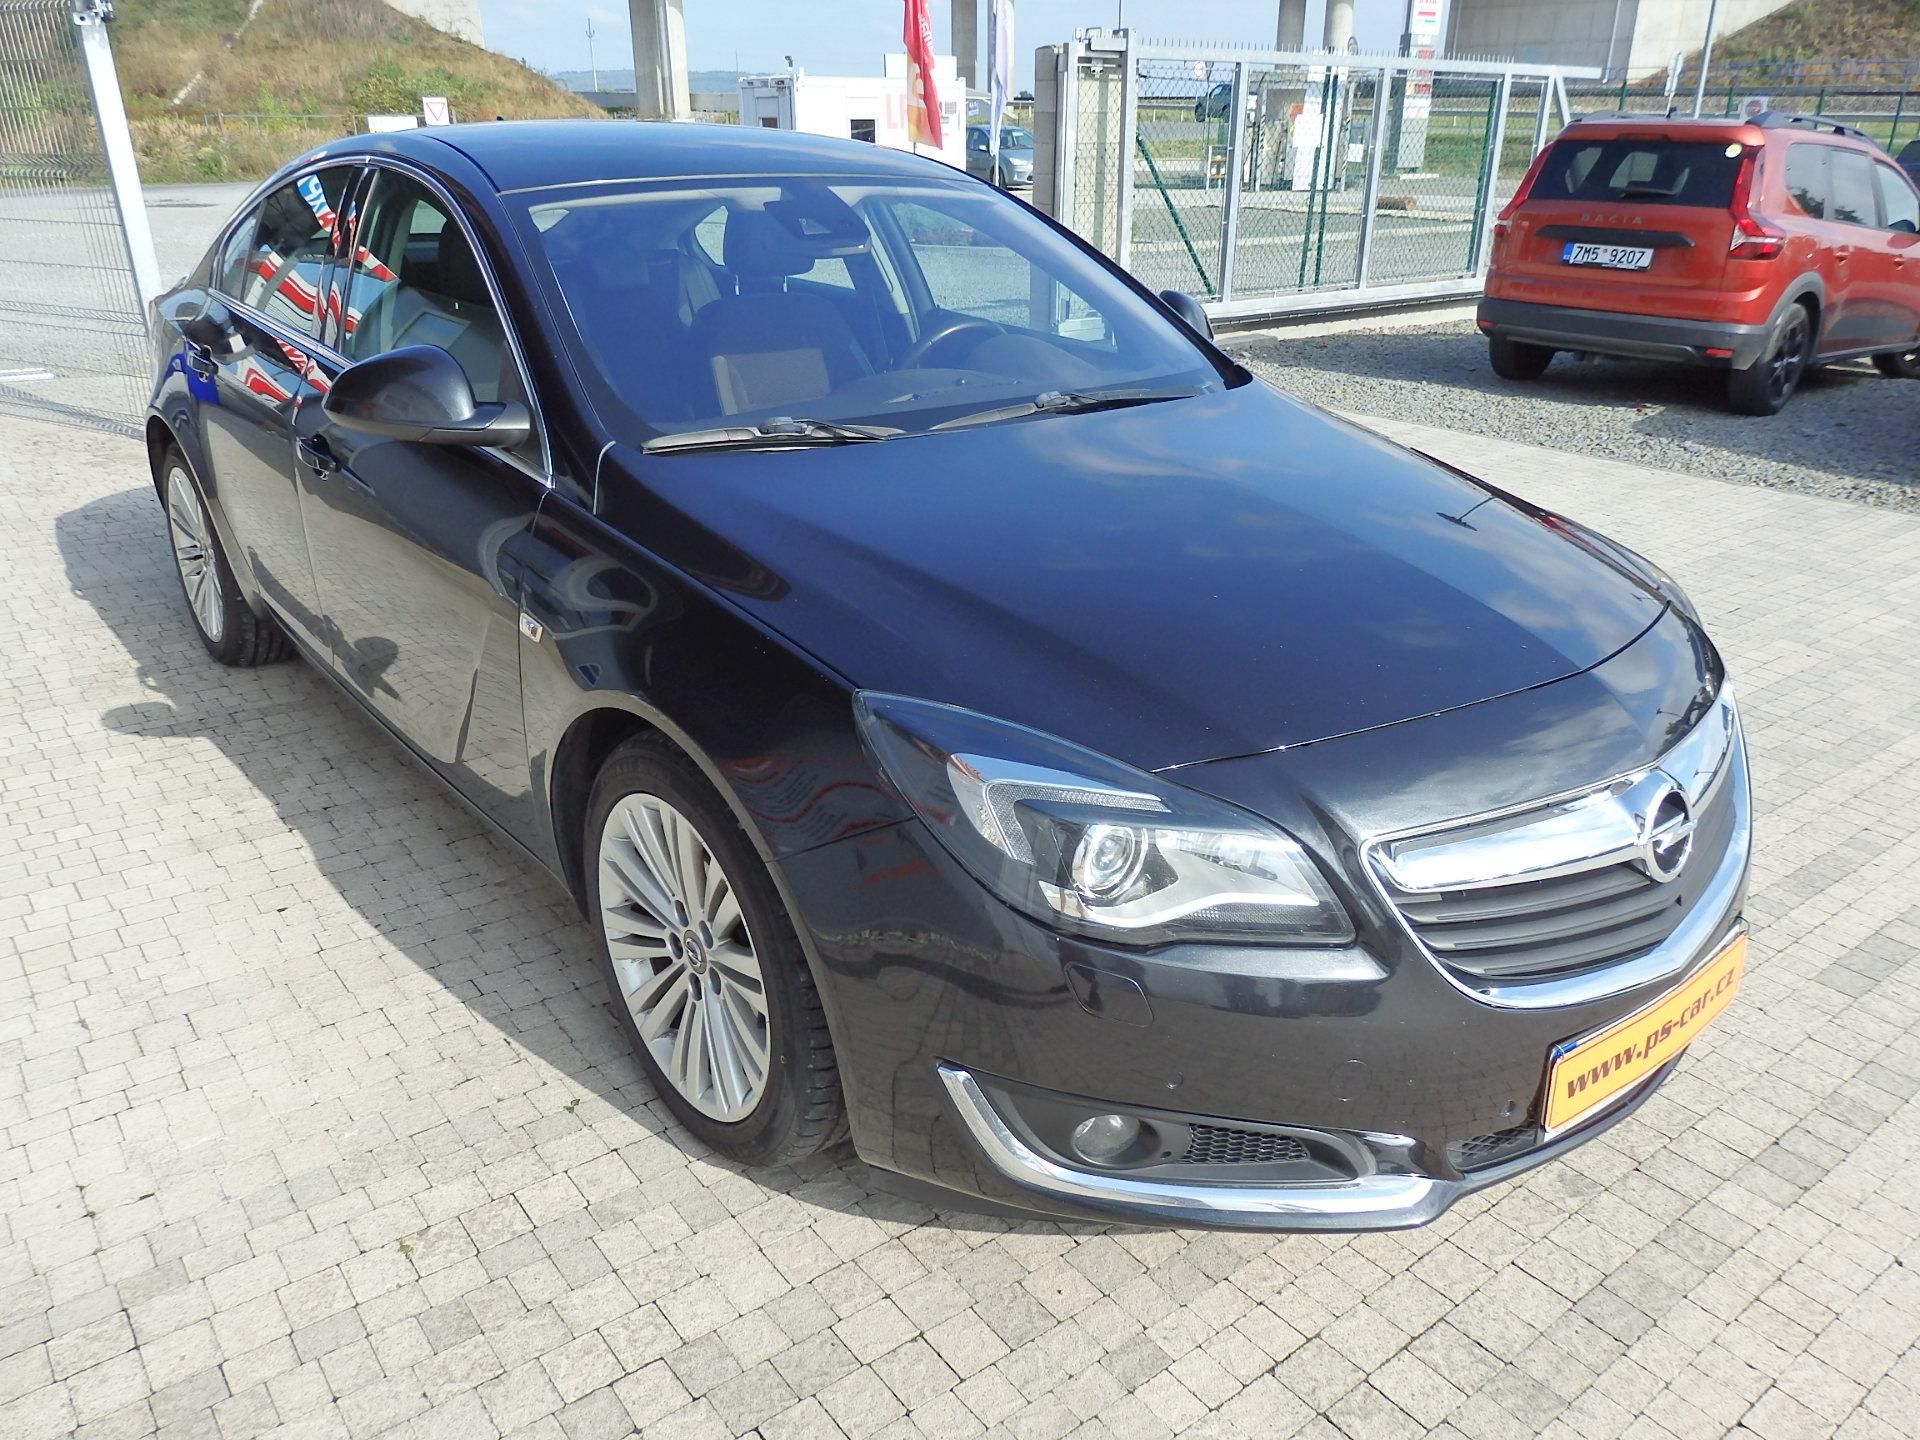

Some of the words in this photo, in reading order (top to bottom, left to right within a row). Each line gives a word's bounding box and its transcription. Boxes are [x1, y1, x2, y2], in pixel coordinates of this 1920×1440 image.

[1582, 214, 1643, 225] DACIA
[1573, 246, 1600, 261] 7M5
[1609, 248, 1646, 264] 9207
[1567, 967, 1735, 1099] www.ps-car.cz
